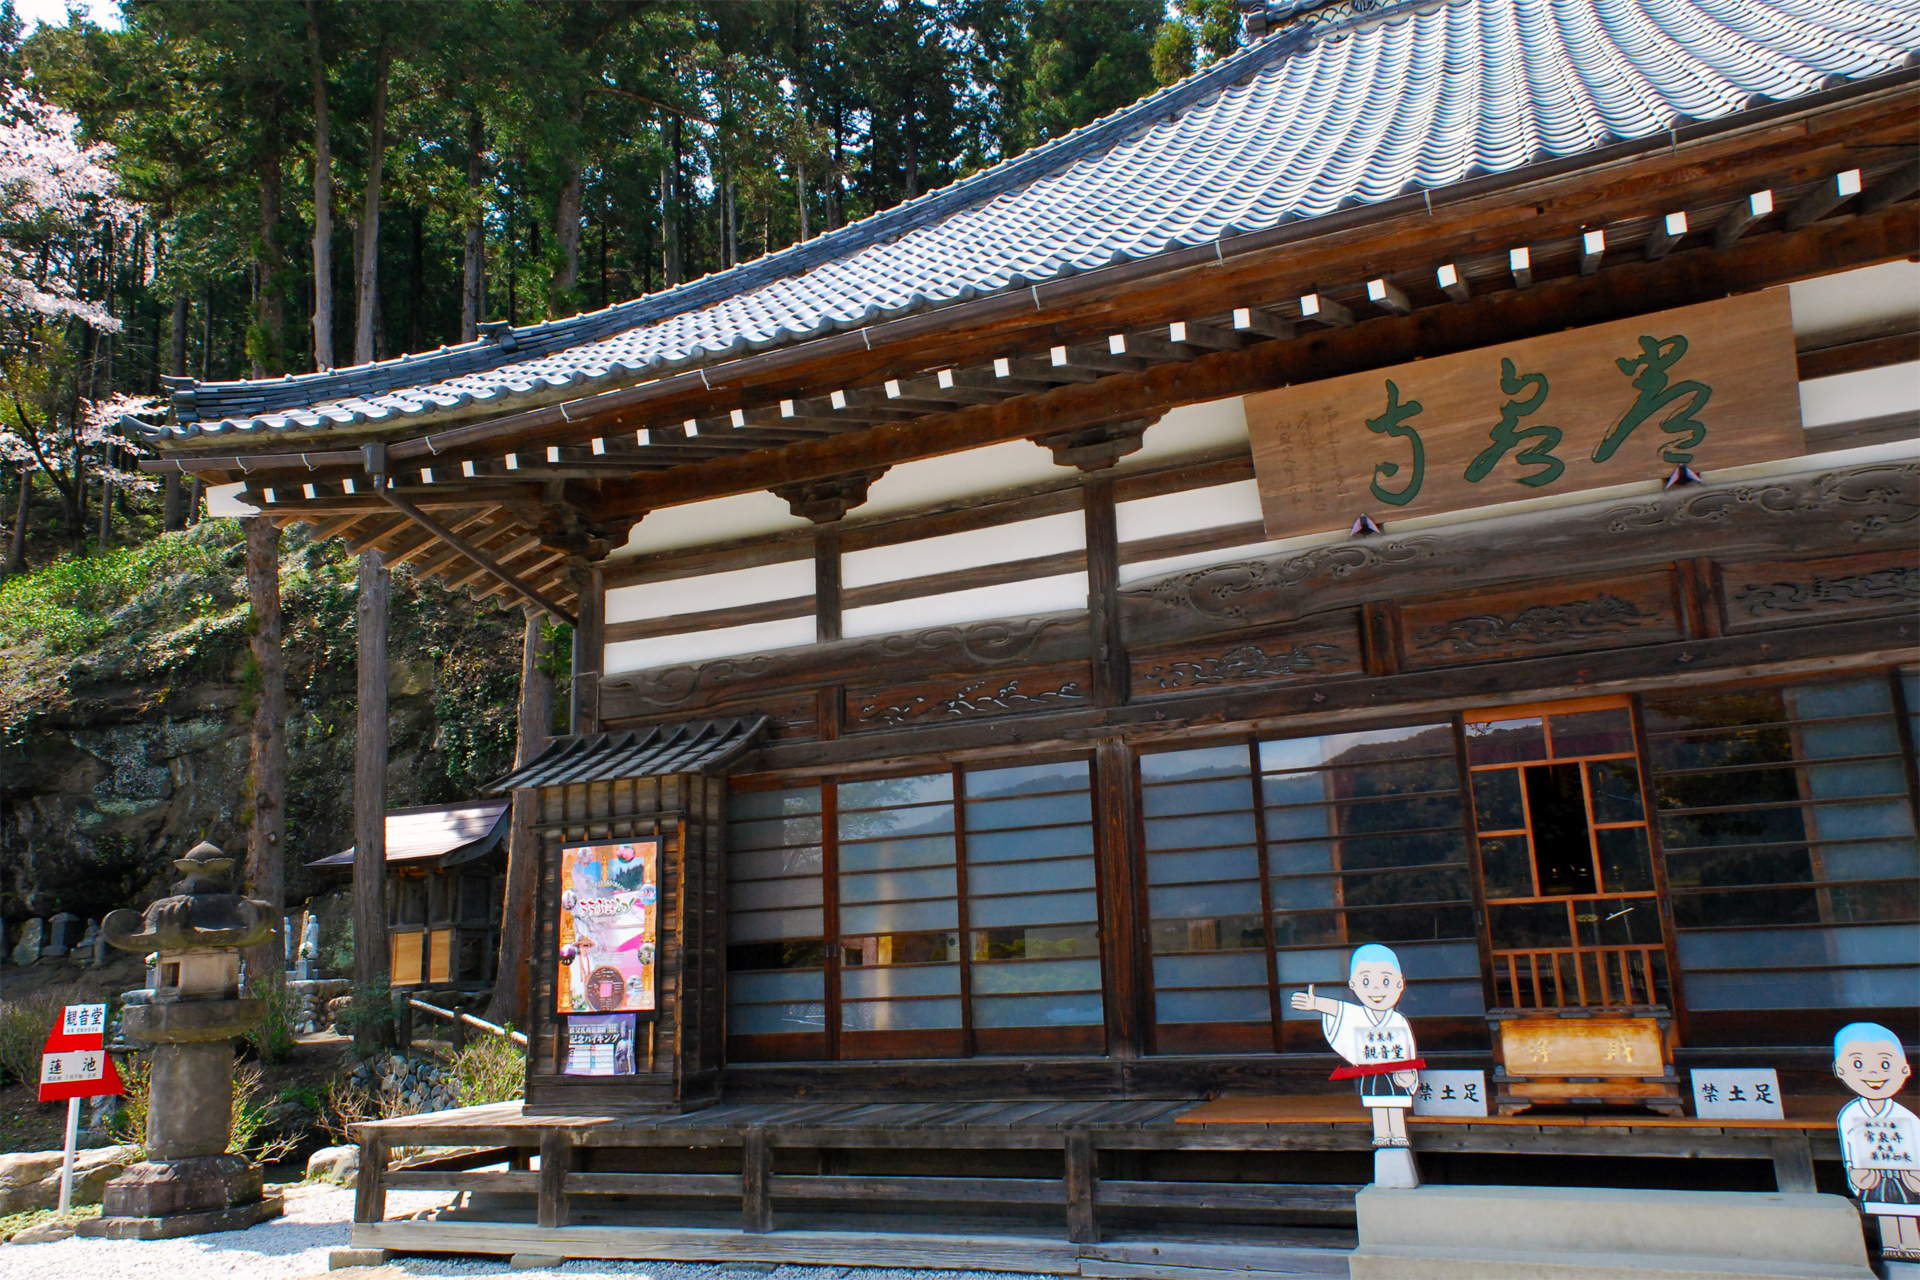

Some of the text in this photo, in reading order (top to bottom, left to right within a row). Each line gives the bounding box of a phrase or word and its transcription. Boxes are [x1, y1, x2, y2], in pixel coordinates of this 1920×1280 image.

[66, 1007, 102, 1026] 観音堂
[1362, 1044, 1404, 1060] 観音堂
[1418, 1083, 1480, 1103] 禁土足
[1701, 1082, 1775, 1104] 禁土足
